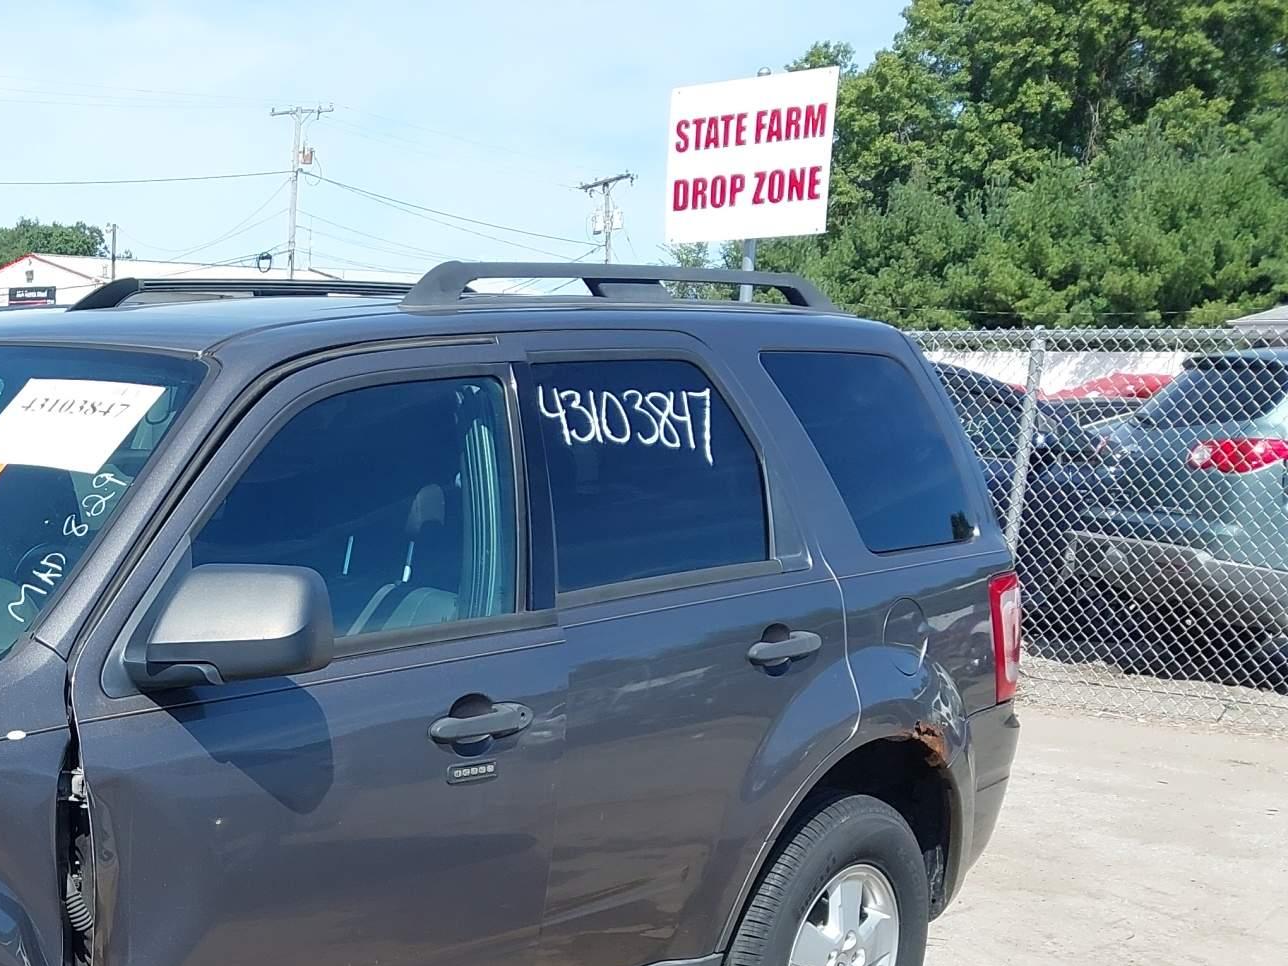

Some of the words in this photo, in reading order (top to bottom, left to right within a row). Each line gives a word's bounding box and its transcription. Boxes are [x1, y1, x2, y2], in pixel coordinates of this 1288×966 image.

[675, 112, 749, 153] STATE
[754, 102, 828, 144] FARM
[672, 174, 745, 212] DROP
[752, 165, 822, 205] ZONE
[21, 397, 131, 418] 43103847
[538, 384, 713, 466] 43103847
